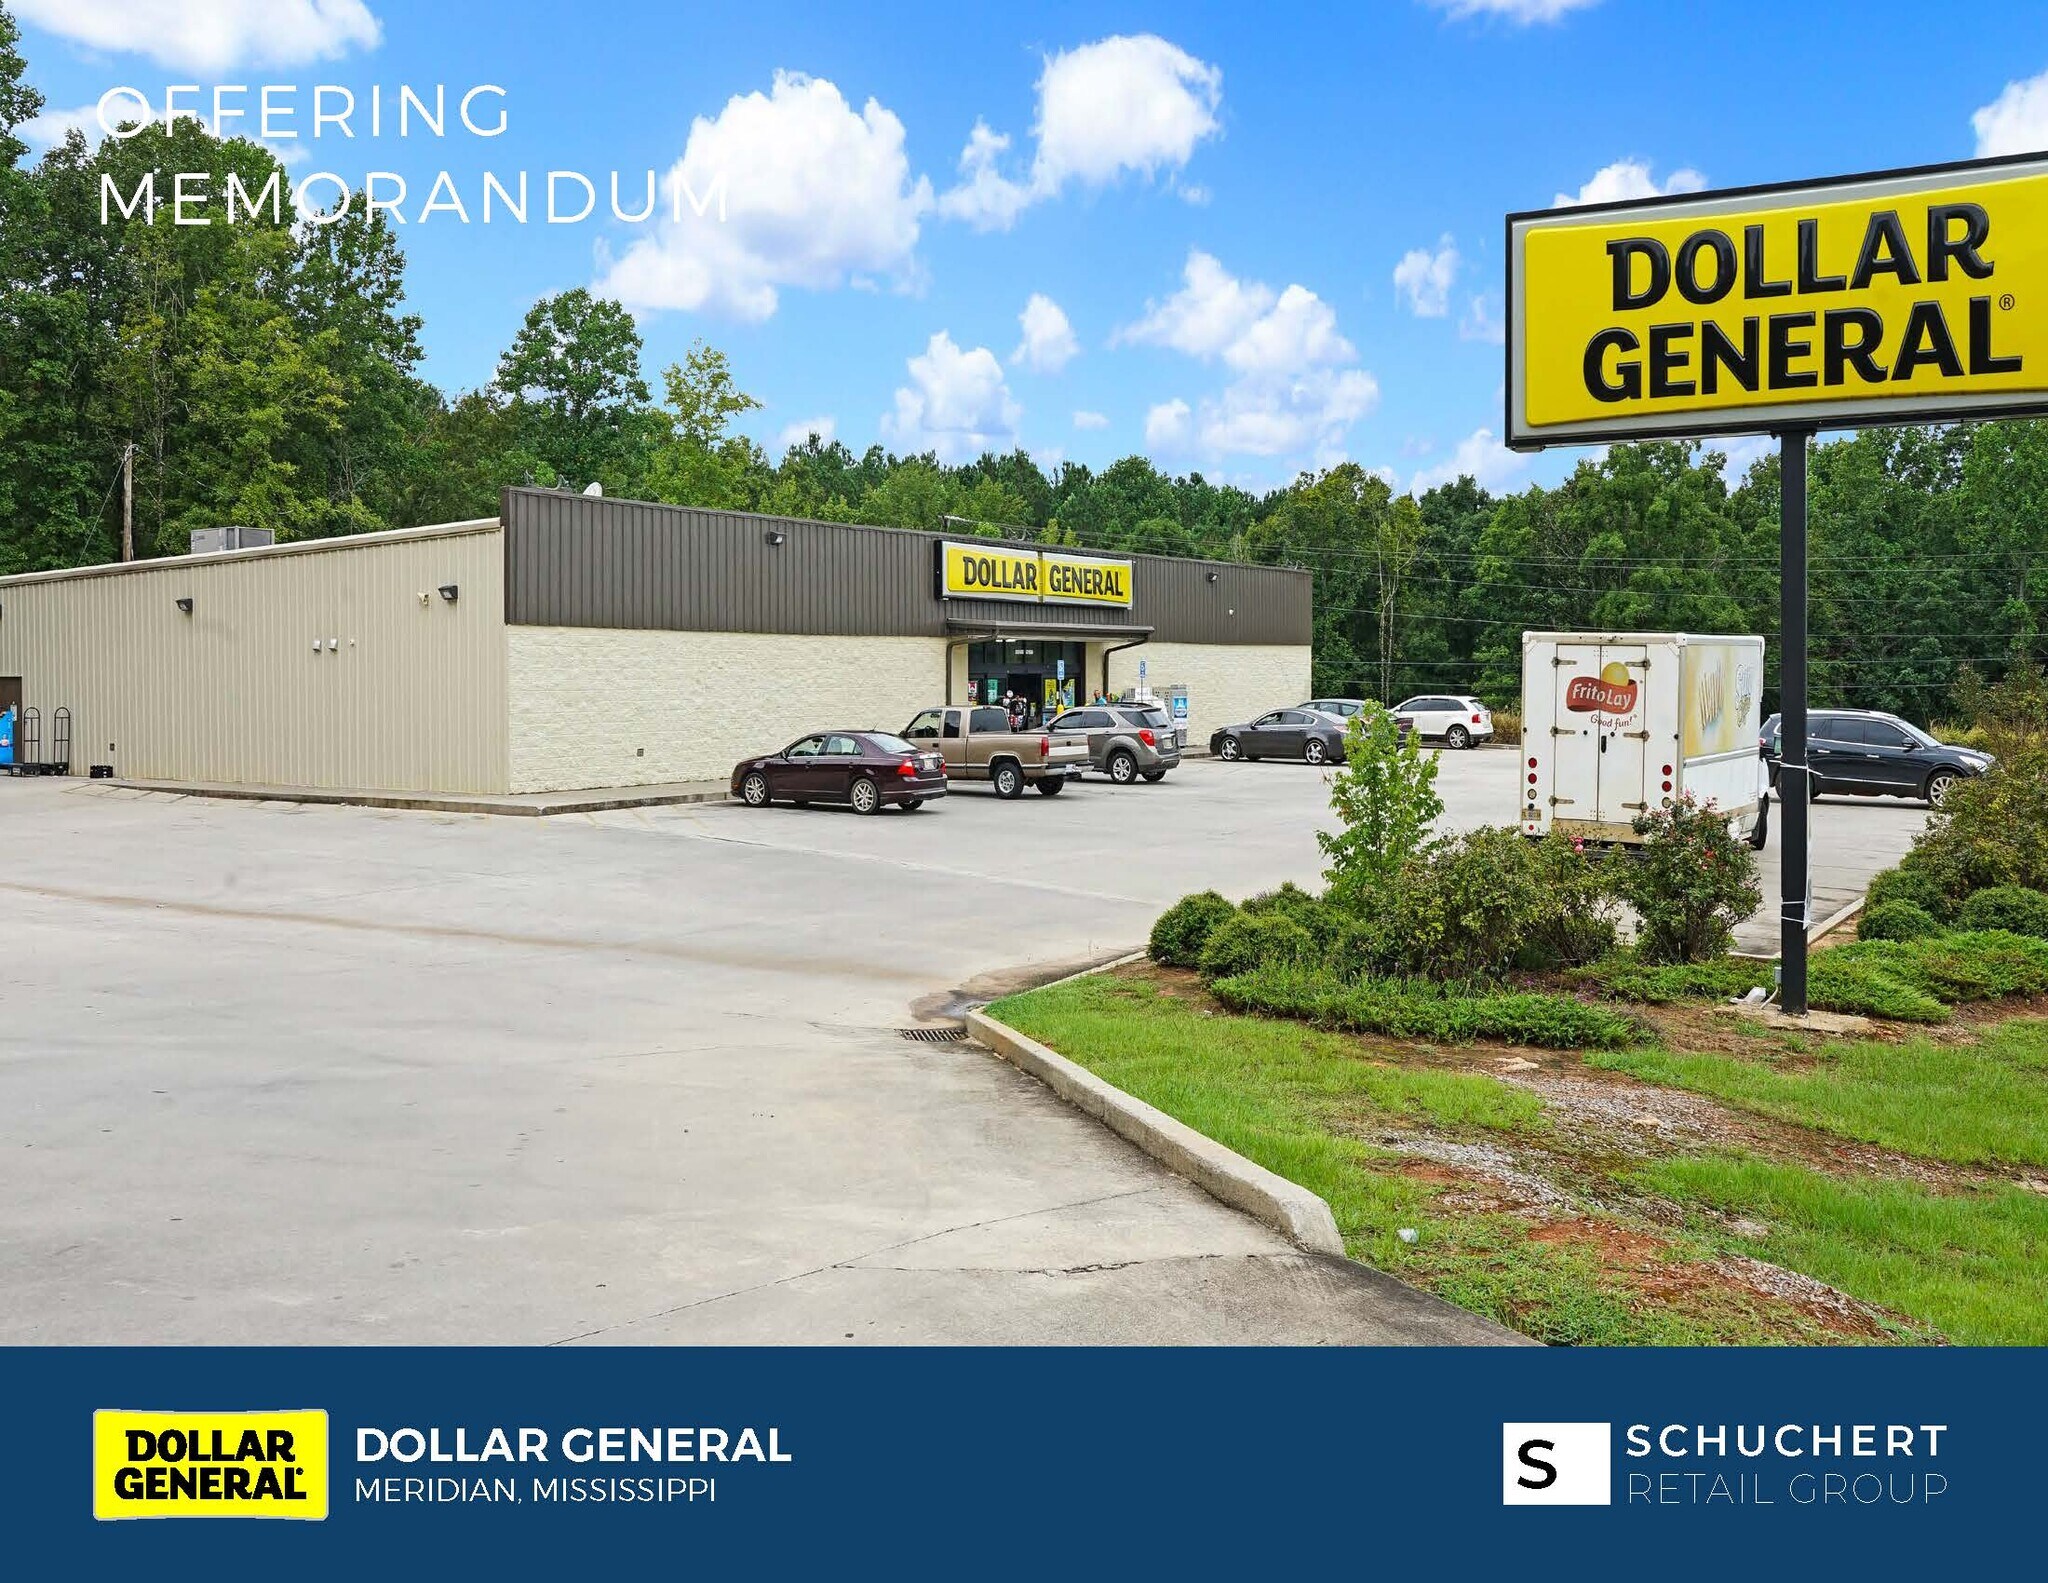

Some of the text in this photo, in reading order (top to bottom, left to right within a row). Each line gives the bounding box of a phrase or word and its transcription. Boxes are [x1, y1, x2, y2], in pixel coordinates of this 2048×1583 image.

[1606, 203, 1994, 311] DOLLAR
[963, 556, 1124, 596] DOLLAR GENERAL
[1590, 714, 1613, 728] Good
